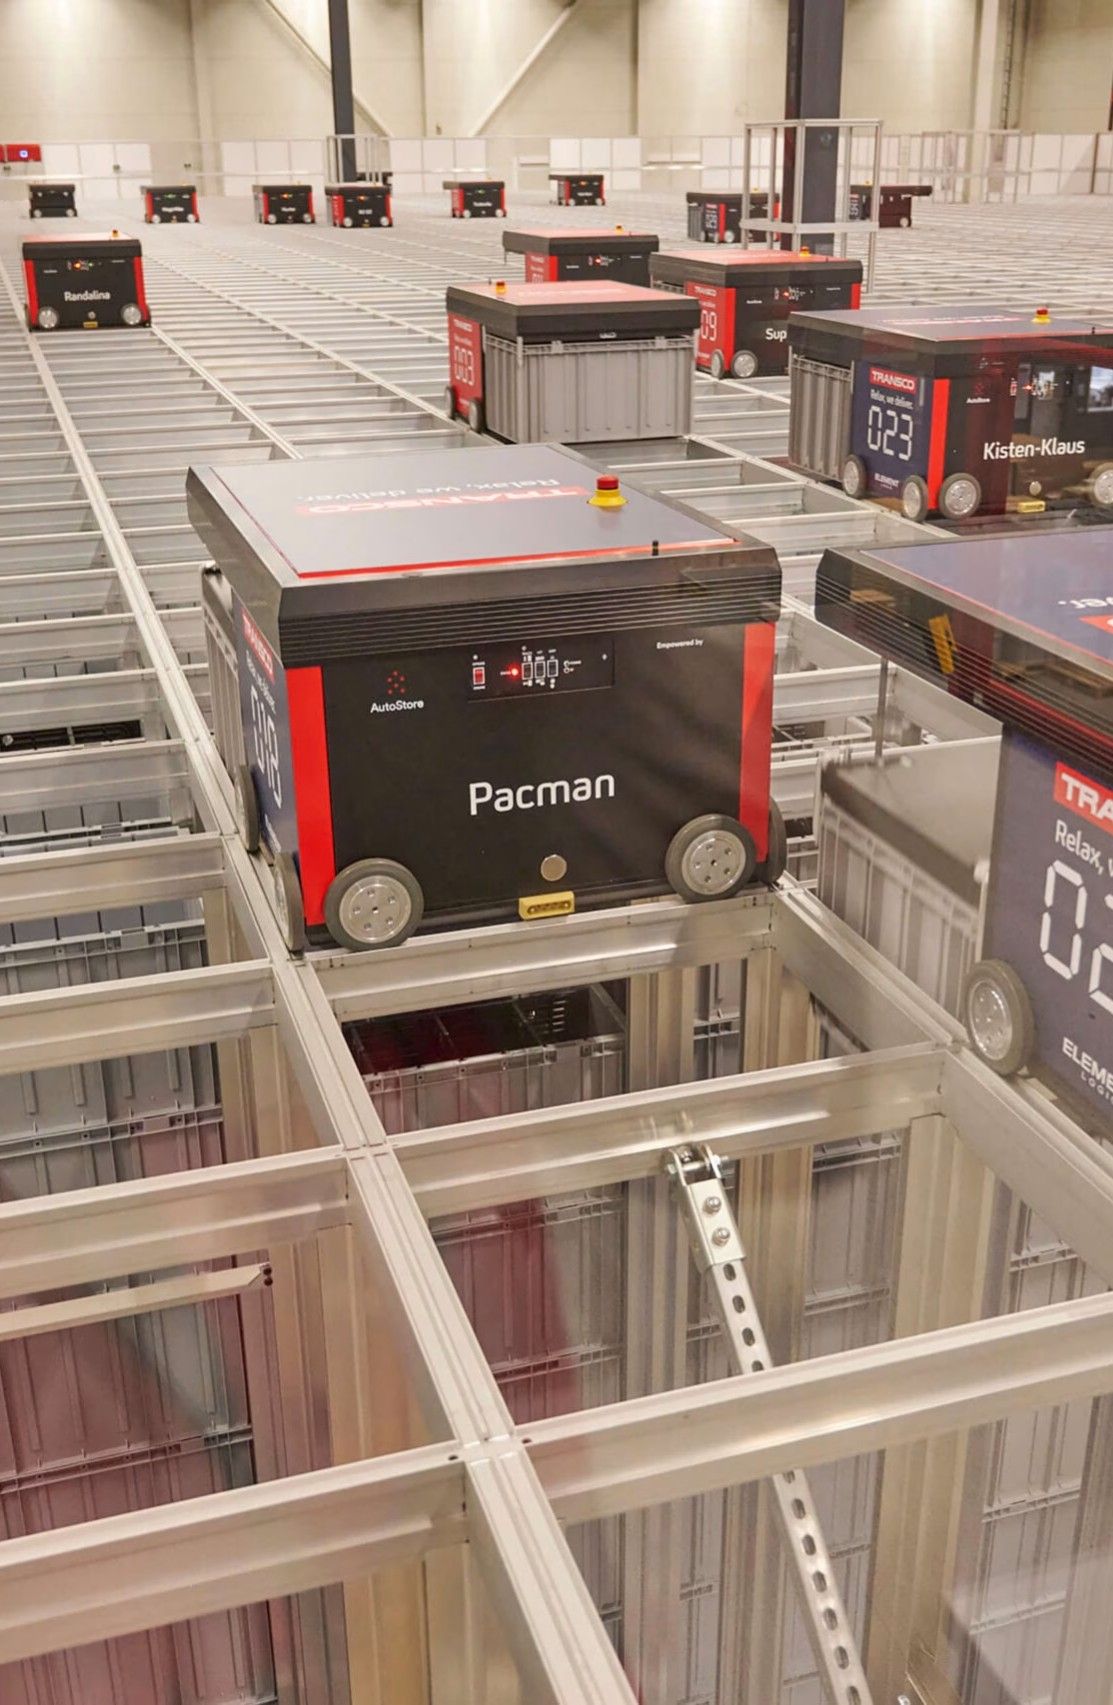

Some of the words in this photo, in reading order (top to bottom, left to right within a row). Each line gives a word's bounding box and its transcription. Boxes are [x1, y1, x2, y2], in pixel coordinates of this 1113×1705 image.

[64, 290, 111, 302] Randalina
[867, 405, 913, 462] 023
[983, 436, 1085, 460] Kisten-Klaus
[370, 700, 424, 714] AutoStore
[251, 684, 282, 809] 018
[469, 774, 615, 816] Pacman
[1055, 819, 1104, 876] Relax,
[1081, 1070, 1113, 1105] LOGI
